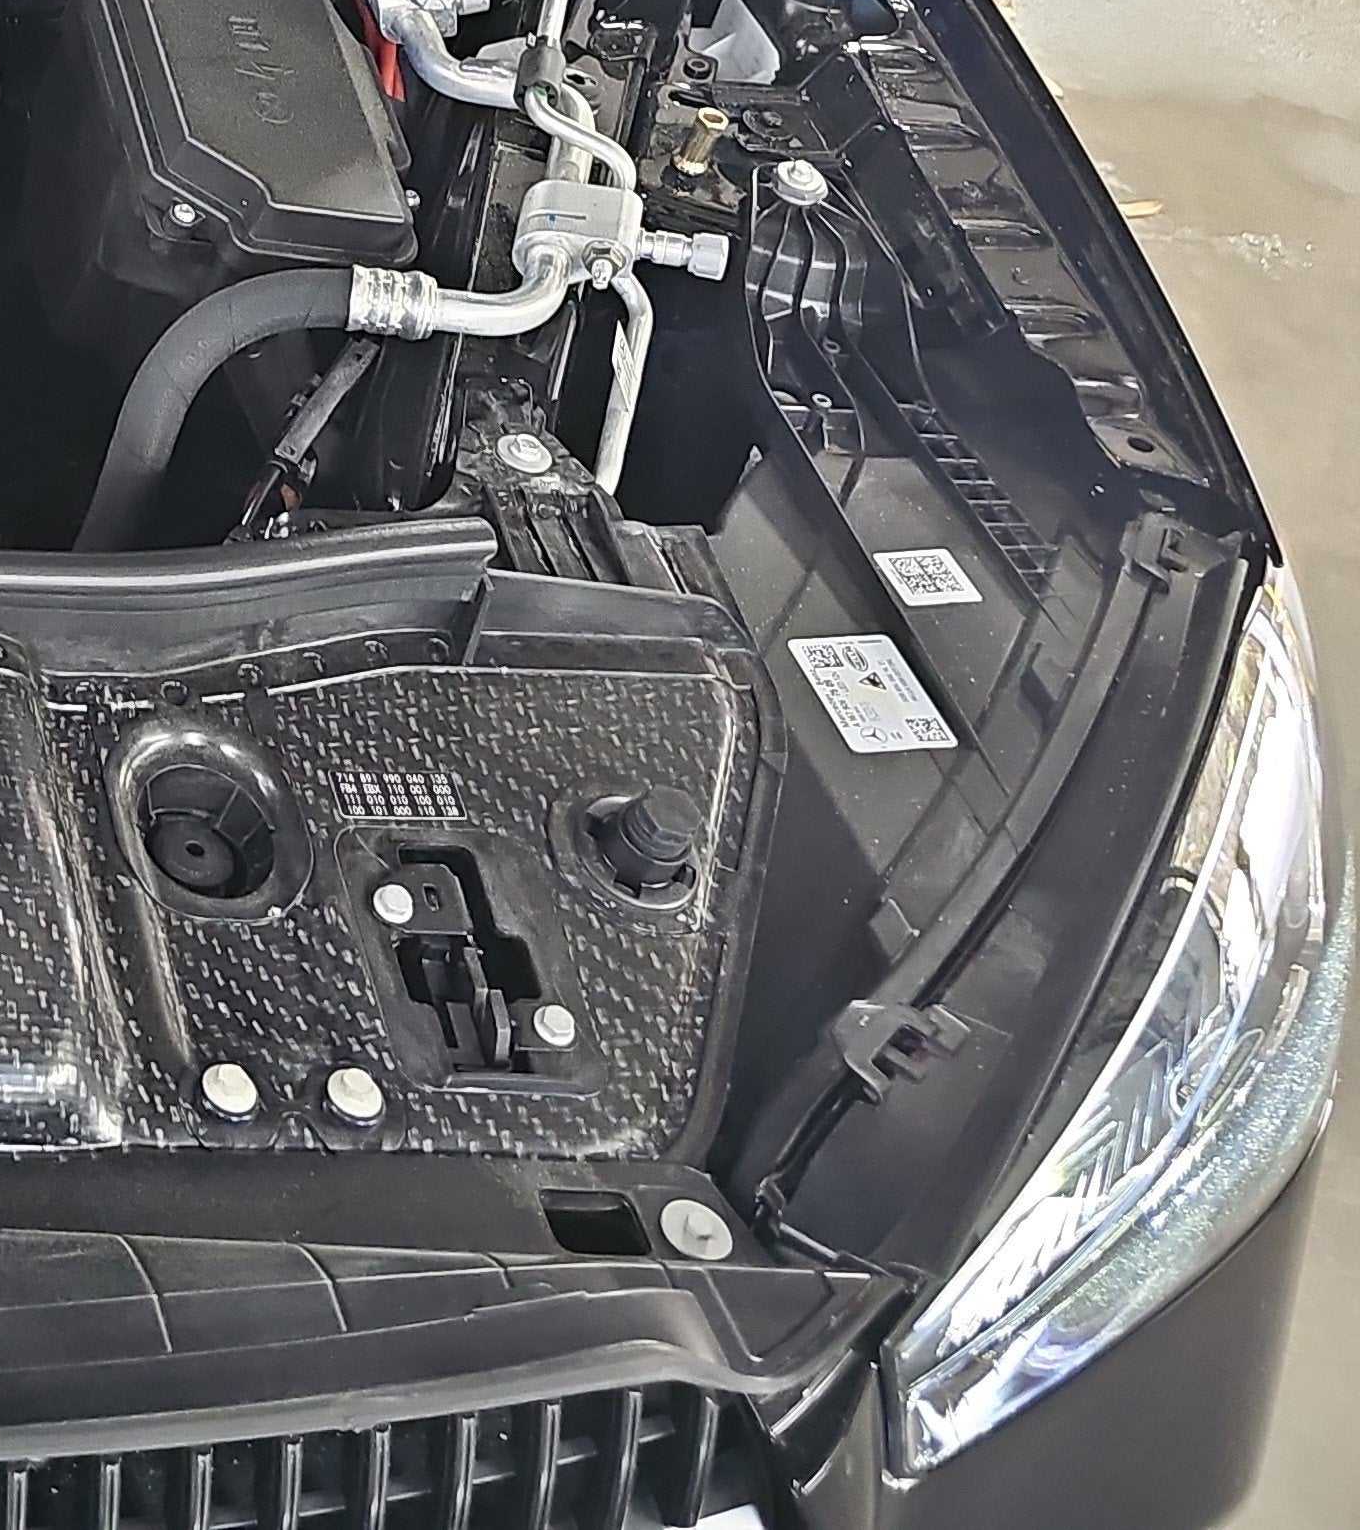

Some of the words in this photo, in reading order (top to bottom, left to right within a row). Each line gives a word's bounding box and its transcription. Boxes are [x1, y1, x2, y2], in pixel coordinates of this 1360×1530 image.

[406, 774, 425, 783] 040
[387, 784, 404, 794] 110
[410, 784, 427, 794] 001
[433, 785, 451, 794] 000
[344, 795, 361, 804] 111
[366, 795, 385, 805] 010
[390, 795, 409, 805] 010
[414, 795, 432, 805] 100
[437, 795, 455, 805] 010
[347, 805, 365, 815] 100
[371, 805, 388, 815] 101
[393, 805, 412, 815] 000
[418, 806, 435, 816] 110
